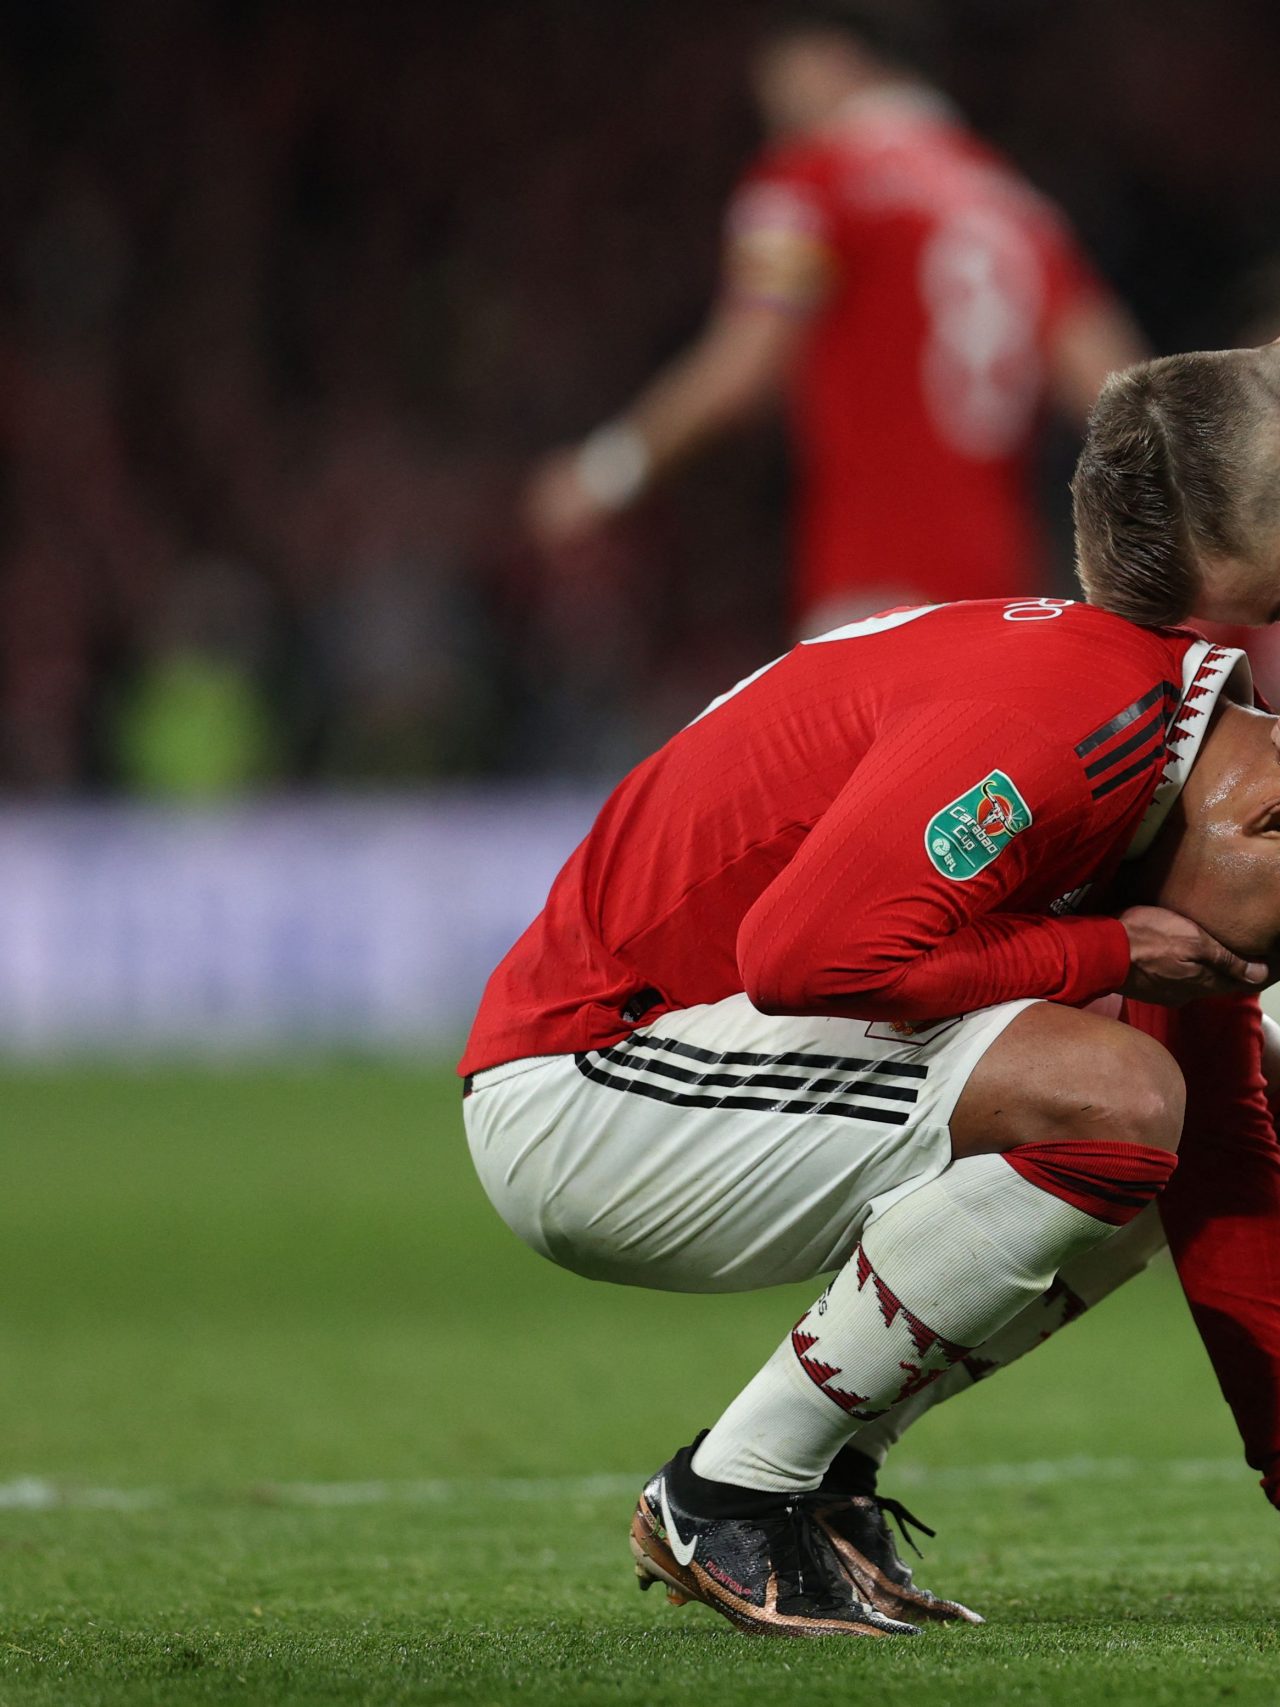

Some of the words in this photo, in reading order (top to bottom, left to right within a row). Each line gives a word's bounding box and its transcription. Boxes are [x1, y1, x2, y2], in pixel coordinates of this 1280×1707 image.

[949, 806, 999, 854] Carabao
[952, 825, 976, 851] Cup
[943, 851, 958, 873] EFL
